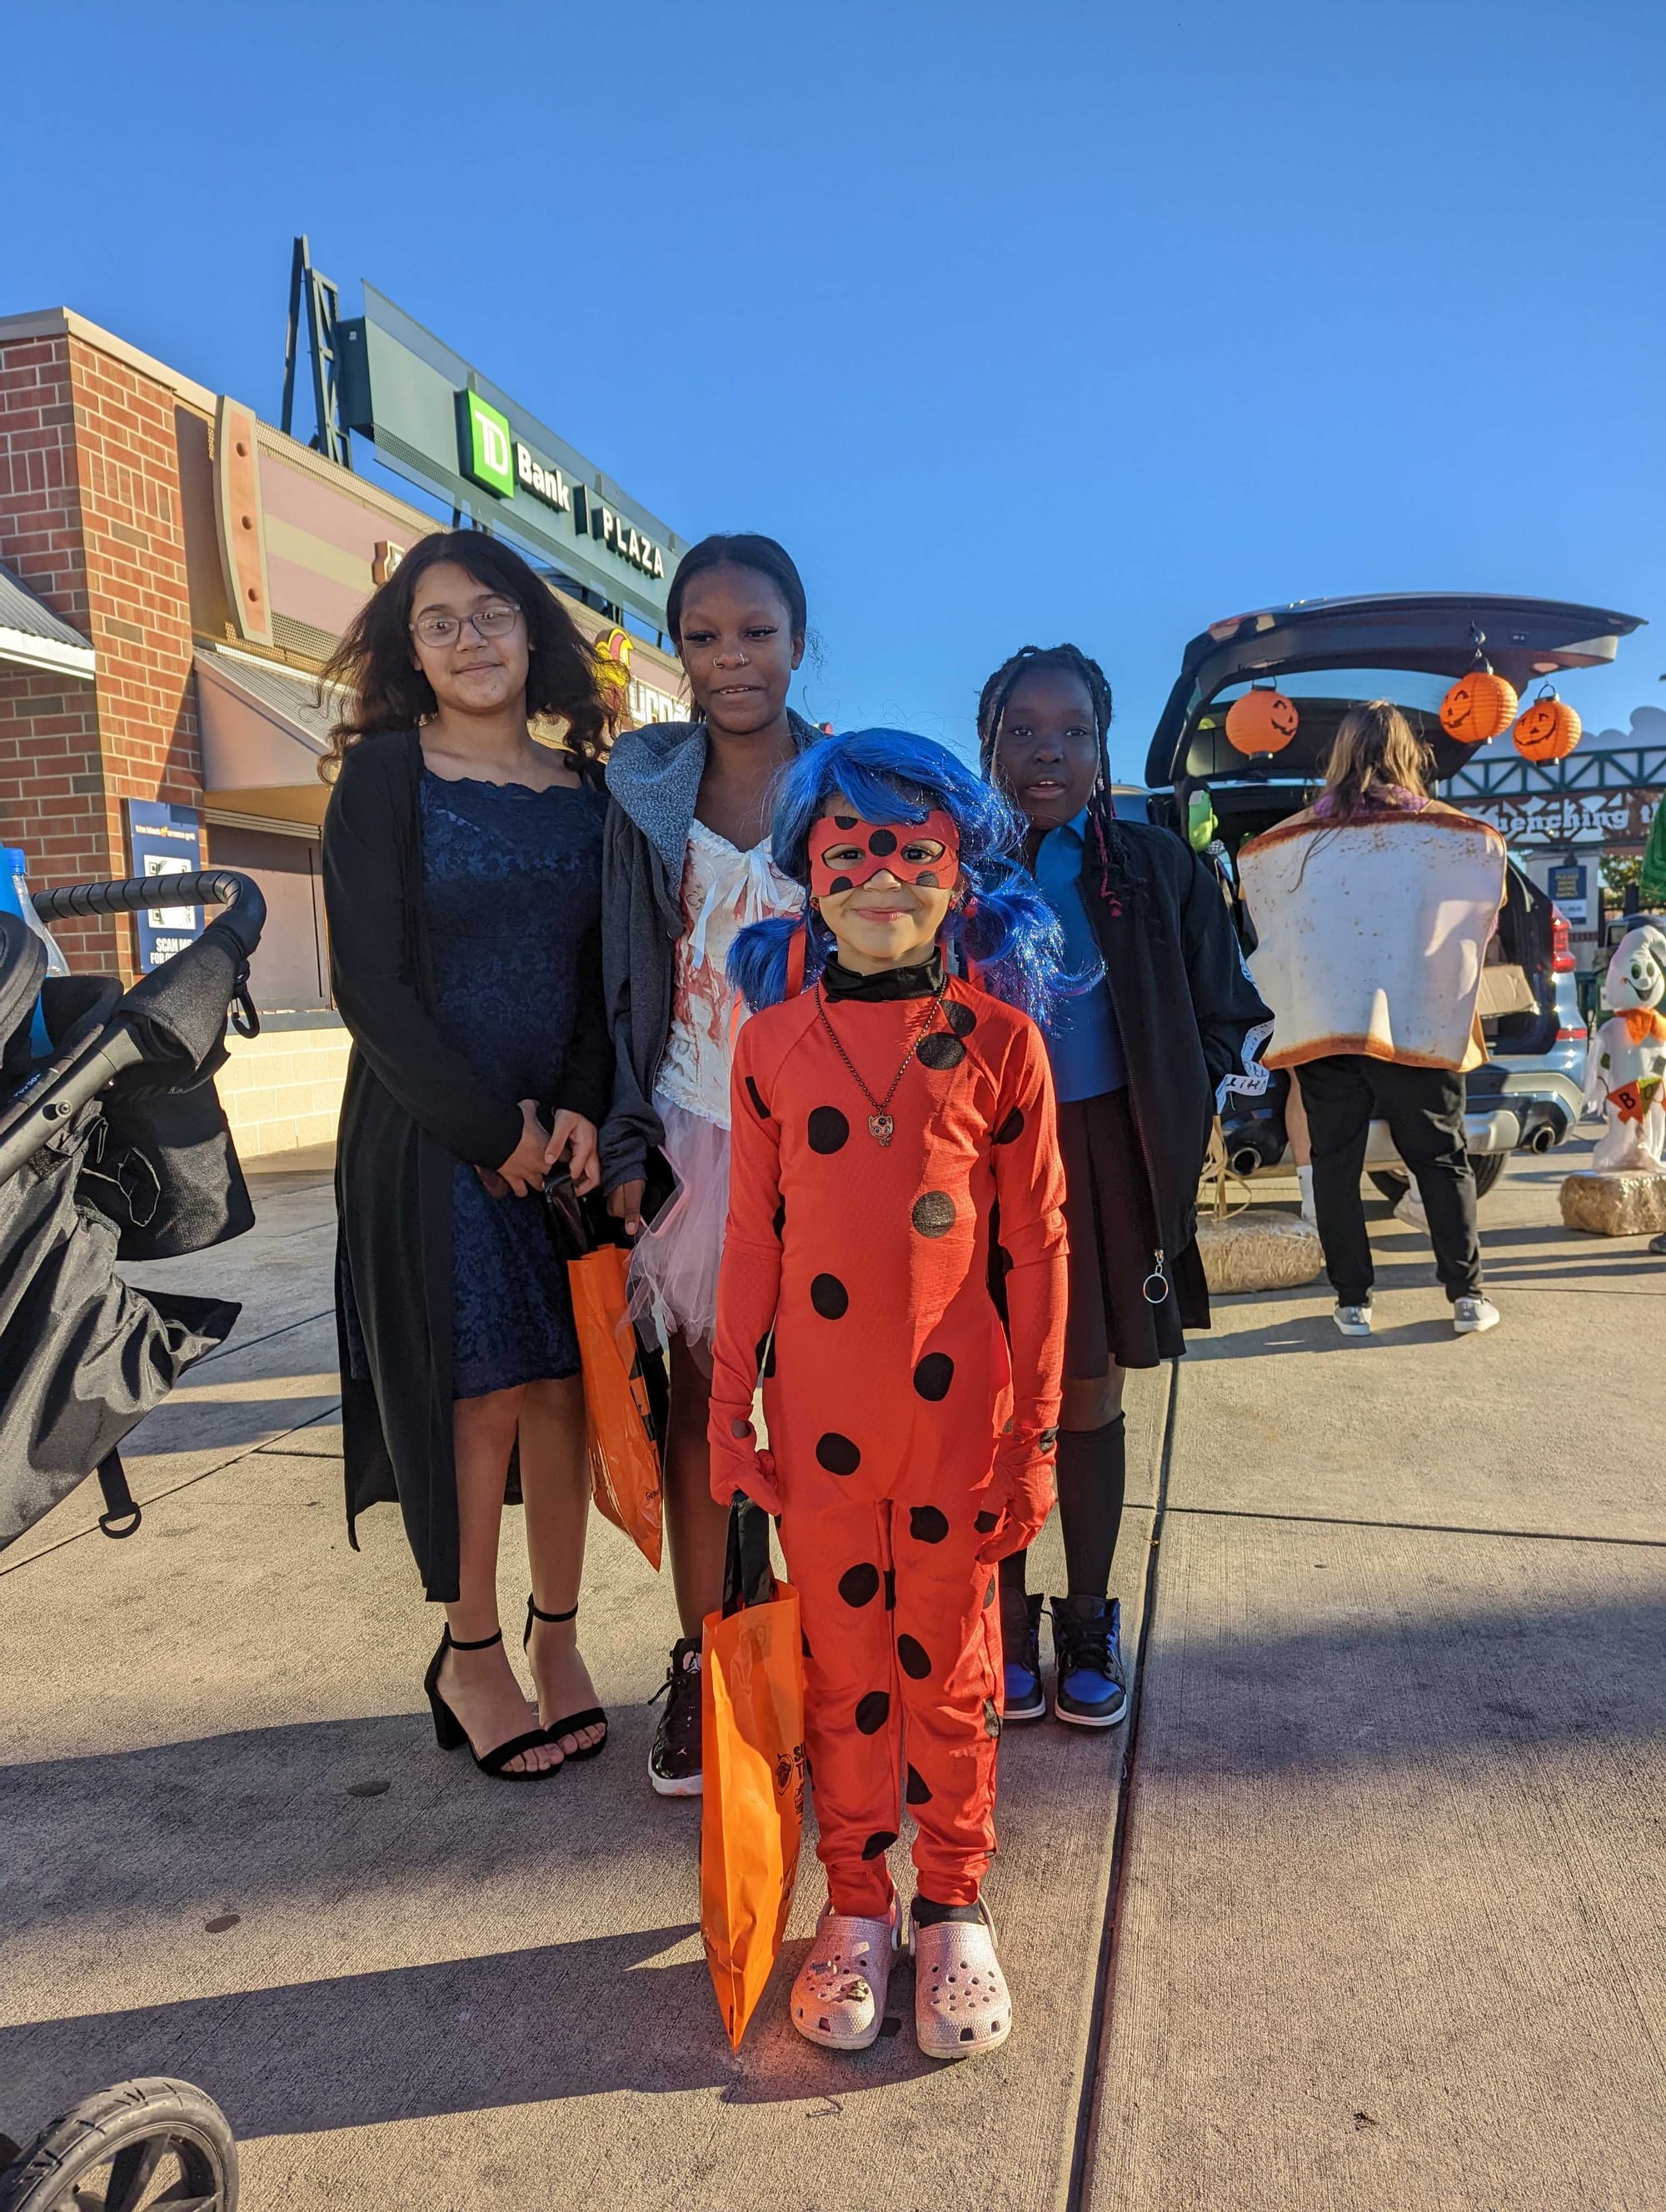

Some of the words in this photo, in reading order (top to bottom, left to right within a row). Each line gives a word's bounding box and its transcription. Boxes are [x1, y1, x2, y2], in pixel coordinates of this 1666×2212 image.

[474, 409, 511, 476] TD
[516, 441, 571, 512] Bank
[601, 506, 665, 579] PLAZA
[1494, 797, 1629, 833] uenching
[150, 952, 165, 964] FOR
[156, 937, 178, 953] SCAN
